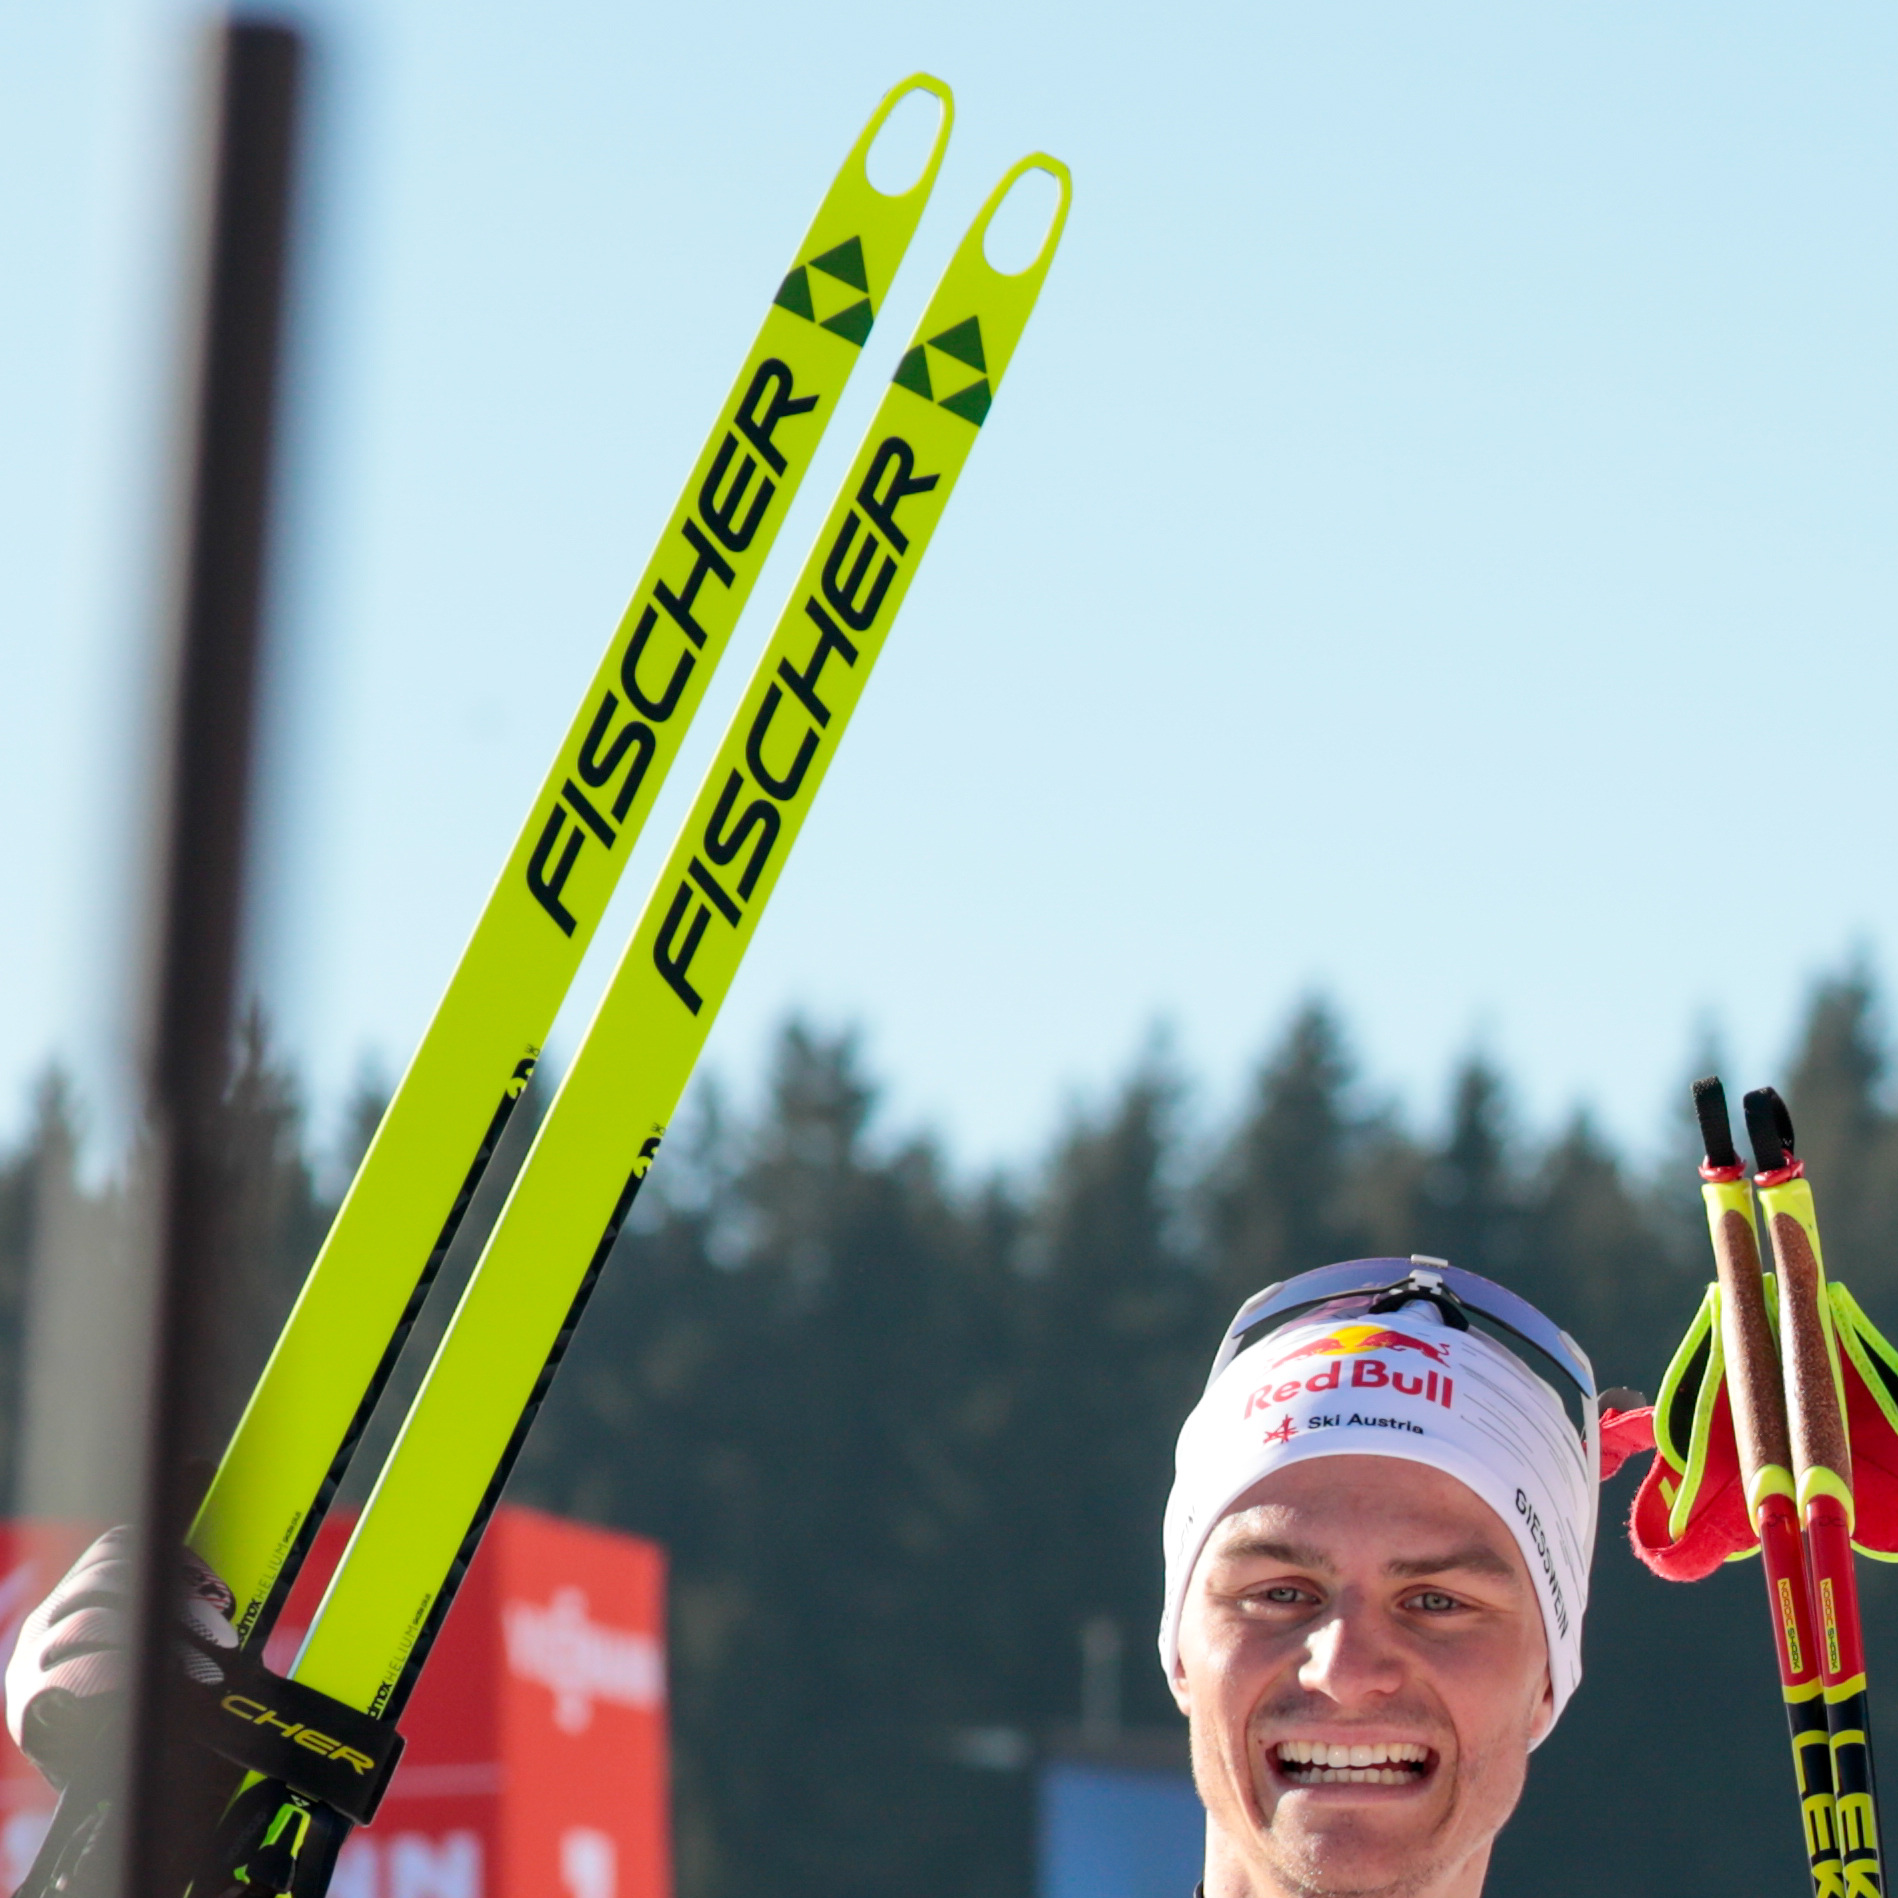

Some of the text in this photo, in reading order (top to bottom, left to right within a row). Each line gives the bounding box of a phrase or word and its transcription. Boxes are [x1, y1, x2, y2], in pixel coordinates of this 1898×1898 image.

[526, 356, 820, 937] FISCHER
[652, 436, 940, 1015] FISCHER
[1243, 1359, 1453, 1419] Red Bull
[1308, 1413, 1424, 1435] Ski Austria
[1514, 1488, 1568, 1641] GIESSWEIN
[221, 1693, 375, 1775] CHER
